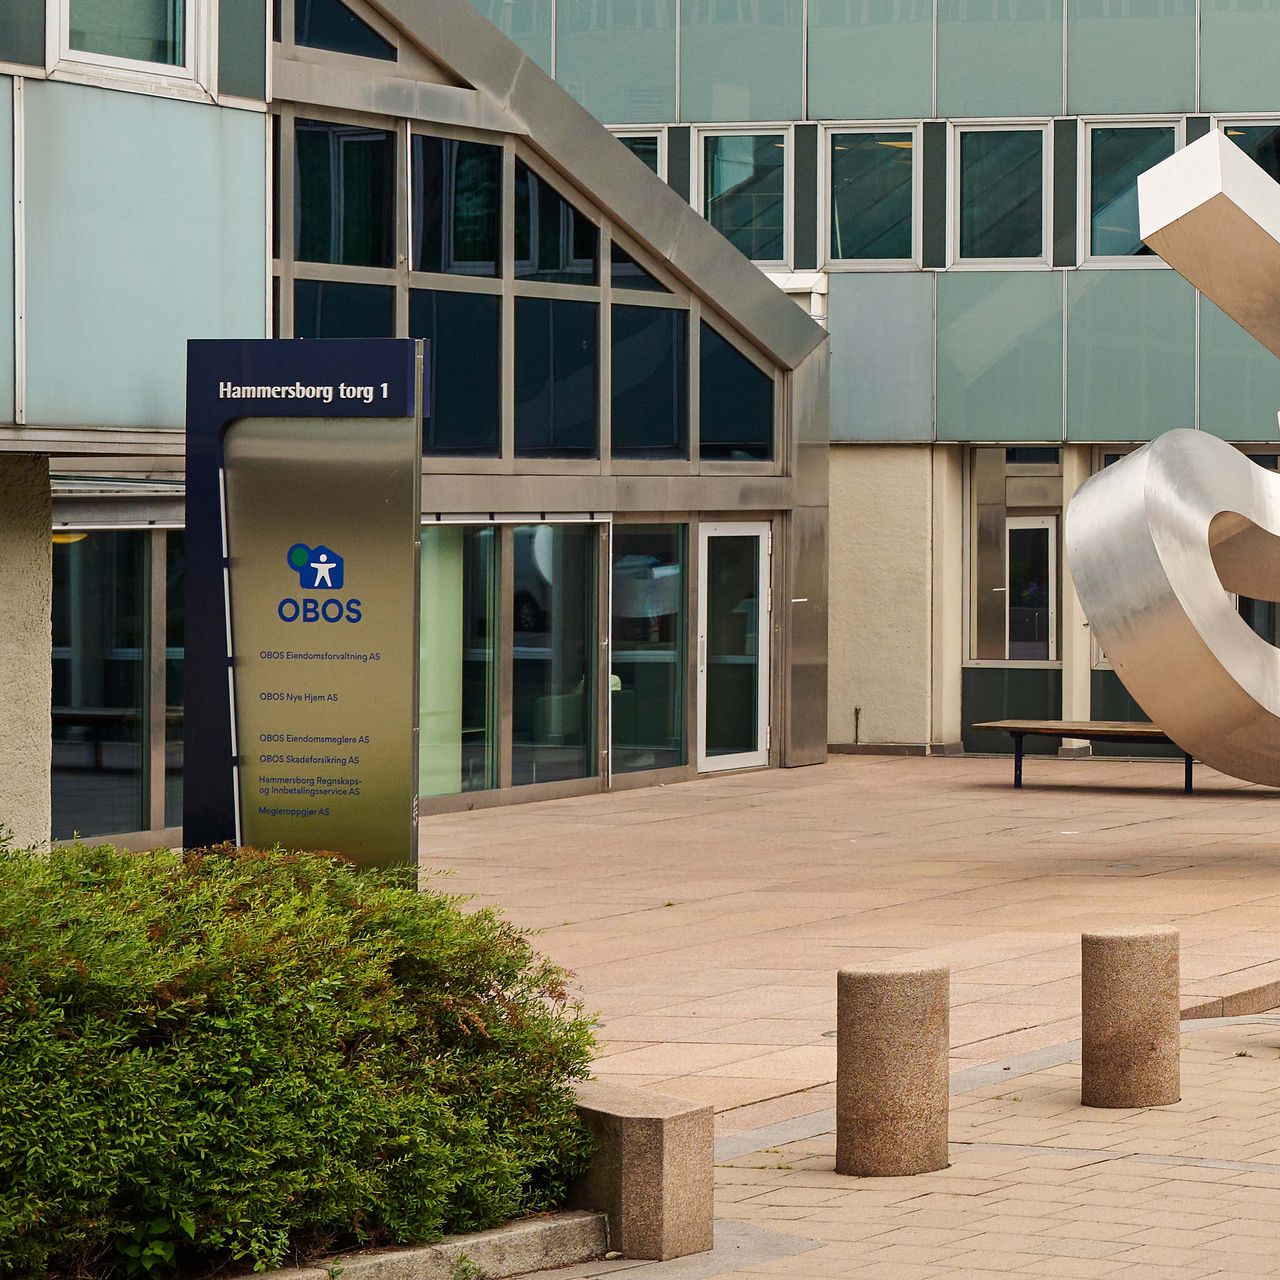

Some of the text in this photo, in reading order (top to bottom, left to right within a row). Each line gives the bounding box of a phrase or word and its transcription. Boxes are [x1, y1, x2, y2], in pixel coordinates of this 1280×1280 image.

[219, 381, 388, 403] Hammersborg torg 1
[278, 597, 362, 623] OBOS
[260, 651, 381, 662] OBOS Eiendomsforvaltning AS
[260, 692, 285, 700] OBOS
[286, 693, 302, 702] Nye
[304, 693, 325, 703] Hjem
[259, 734, 284, 742] OBOS
[286, 734, 357, 745] Eiendomsmeglere
[259, 755, 360, 766] OBOS Skadeforsikring AS
[259, 776, 362, 787] Hammersborg Regnskaps-
[259, 787, 270, 796] og
[271, 786, 347, 797] Innbetalingsservice
[318, 807, 330, 816] AS
